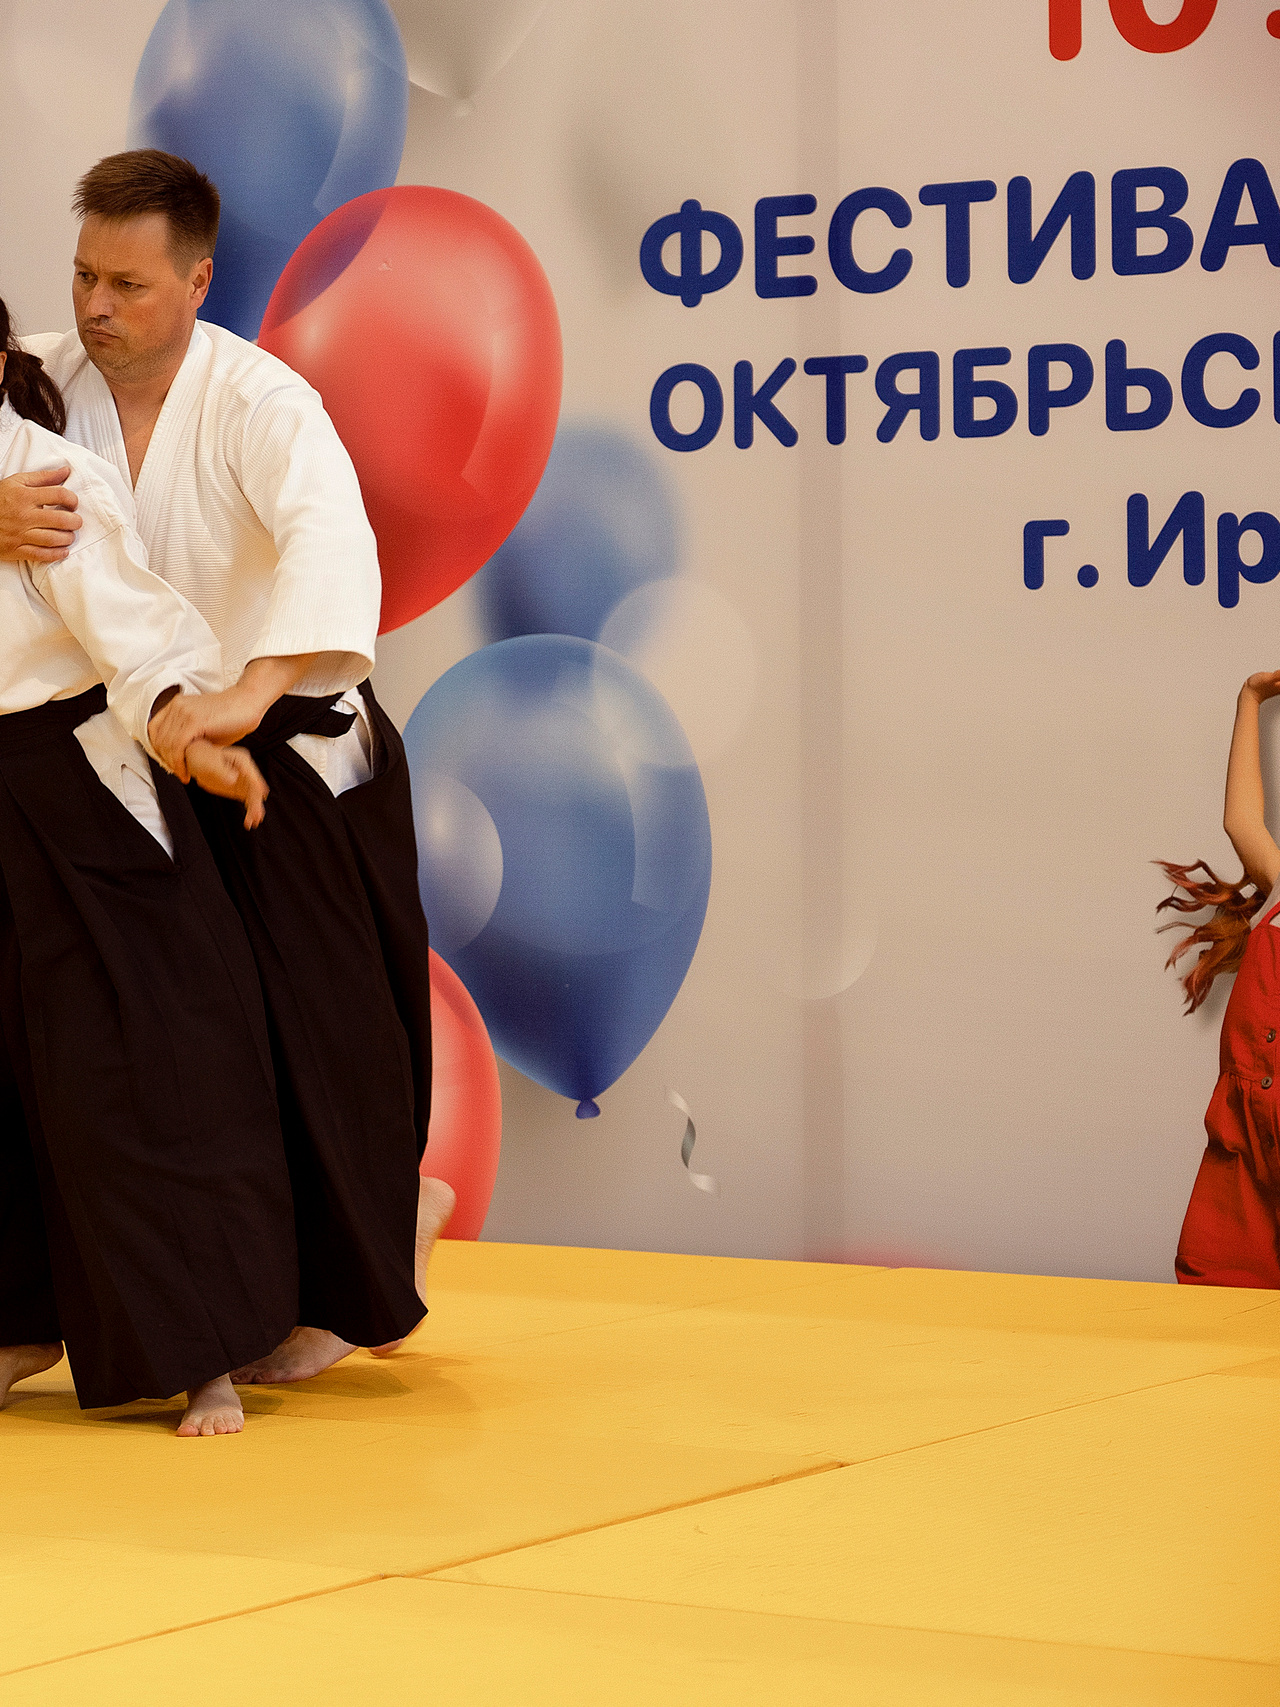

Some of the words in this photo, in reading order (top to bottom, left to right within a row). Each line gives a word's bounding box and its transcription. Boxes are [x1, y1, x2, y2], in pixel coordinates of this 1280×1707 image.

[638, 157, 1280, 308] ФЕСТИВА
[649, 329, 1280, 453] ОКТЯБРЬС
[1022, 518, 1099, 590] г.
[1126, 490, 1280, 609] Ир
